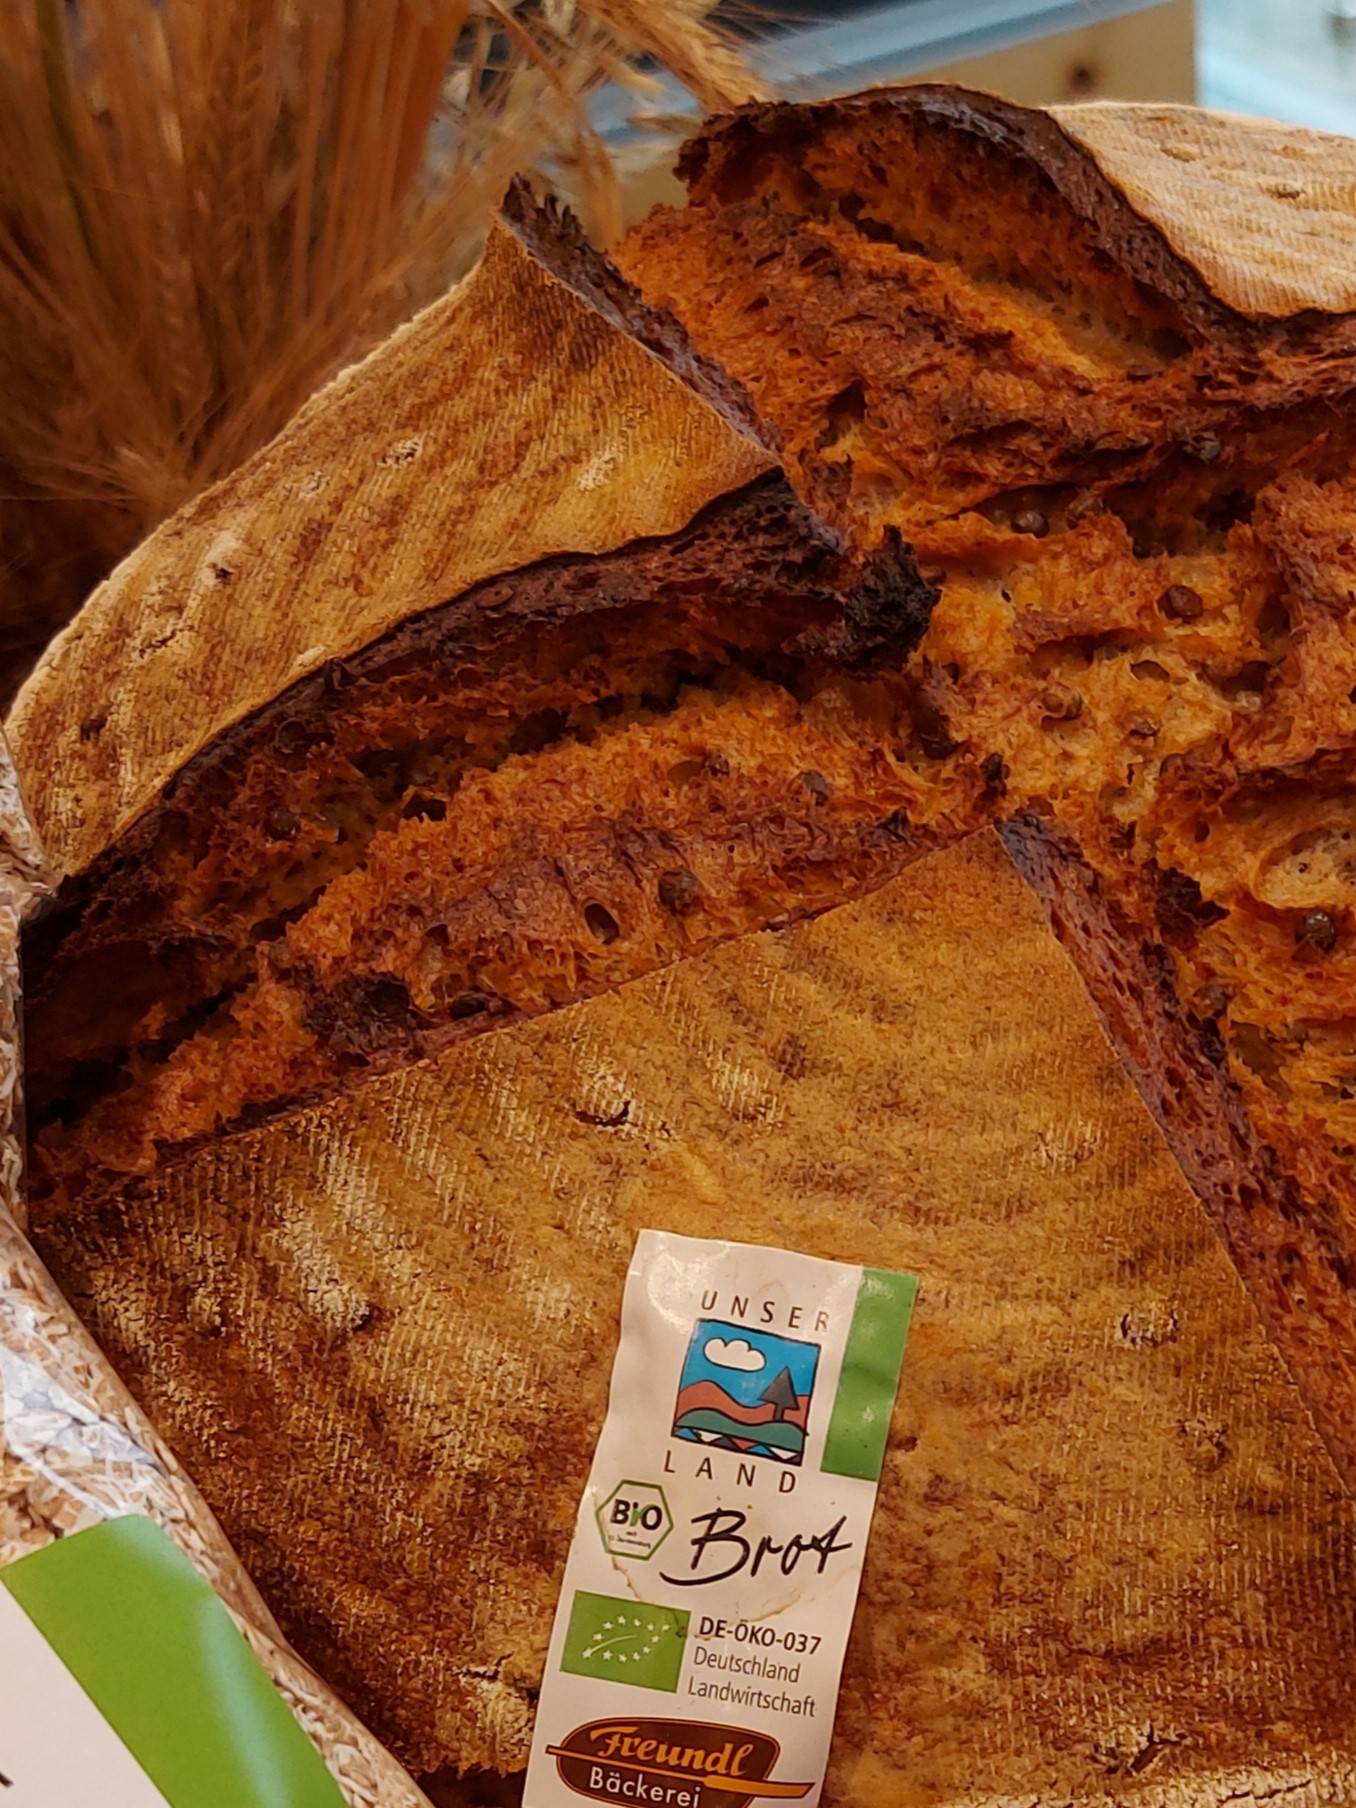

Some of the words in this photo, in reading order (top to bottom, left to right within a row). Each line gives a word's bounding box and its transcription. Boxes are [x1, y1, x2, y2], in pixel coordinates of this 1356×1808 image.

[701, 1290, 831, 1332] UNSER
[663, 1450, 796, 1495] LAND
[660, 1507, 853, 1588] Brot
[698, 1613, 822, 1658] DE-ÖKO-037
[692, 1645, 801, 1686] Deutschland
[687, 1676, 817, 1718] Landwirtschaft
[588, 1724, 755, 1777] Freundl
